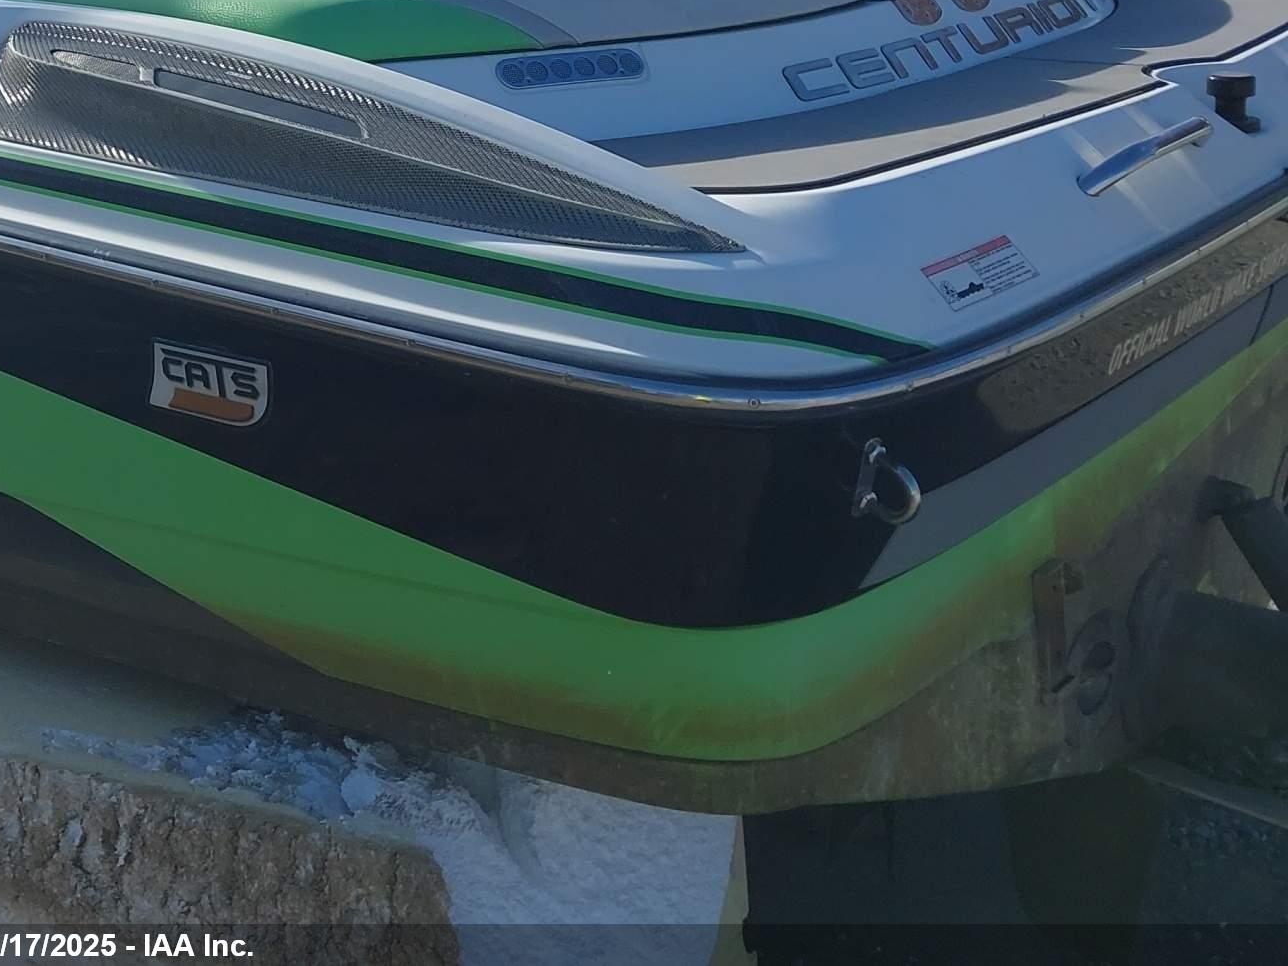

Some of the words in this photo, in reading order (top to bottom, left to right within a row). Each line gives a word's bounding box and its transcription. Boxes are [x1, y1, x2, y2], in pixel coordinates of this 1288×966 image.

[1108, 314, 1173, 375] OFFICIAL
[1174, 284, 1223, 336] WORLD
[160, 347, 261, 401] CATS
